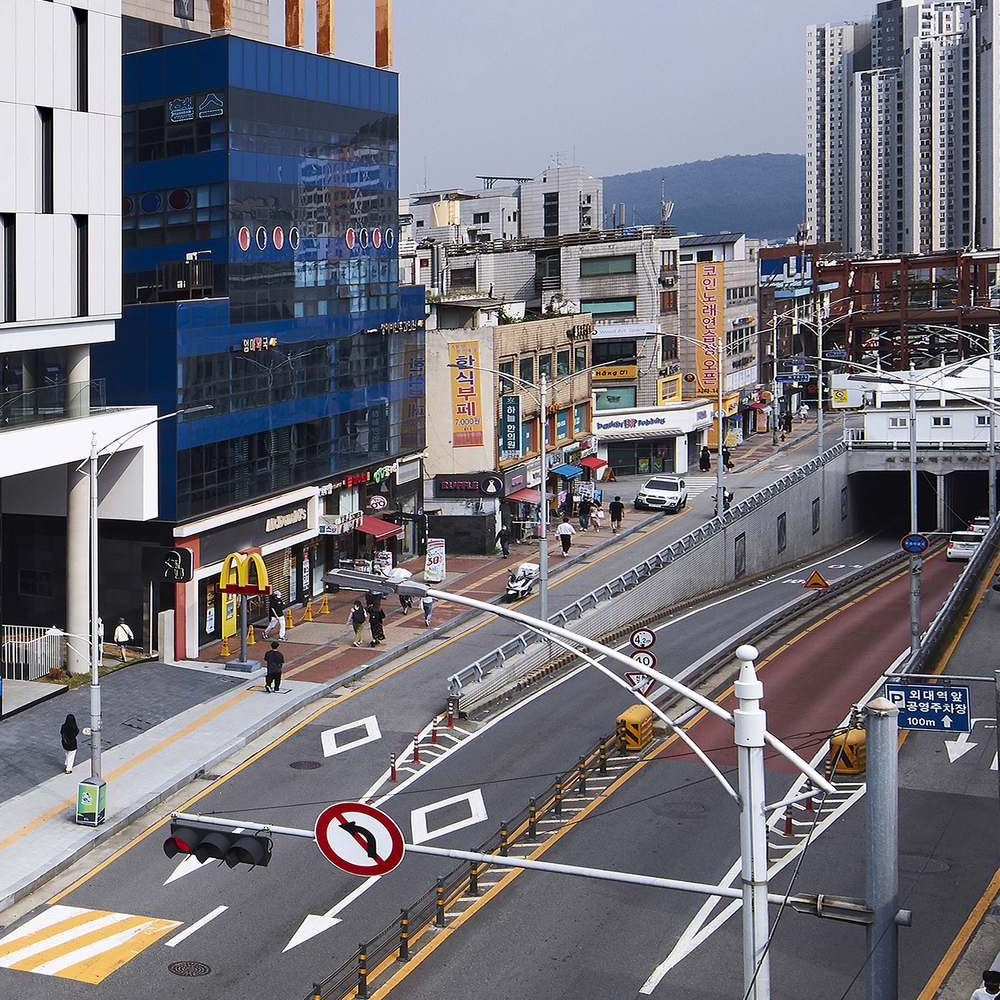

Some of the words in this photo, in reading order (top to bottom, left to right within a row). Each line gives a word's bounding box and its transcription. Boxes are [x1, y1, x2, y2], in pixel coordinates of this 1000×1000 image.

[702, 359, 718, 386] 오픈
[455, 355, 477, 416] 한식부페
[441, 481, 479, 490] RUFFLE
[636, 656, 650, 666] 40
[906, 701, 967, 715] 공영주차장
[907, 716, 936, 727] 100m
